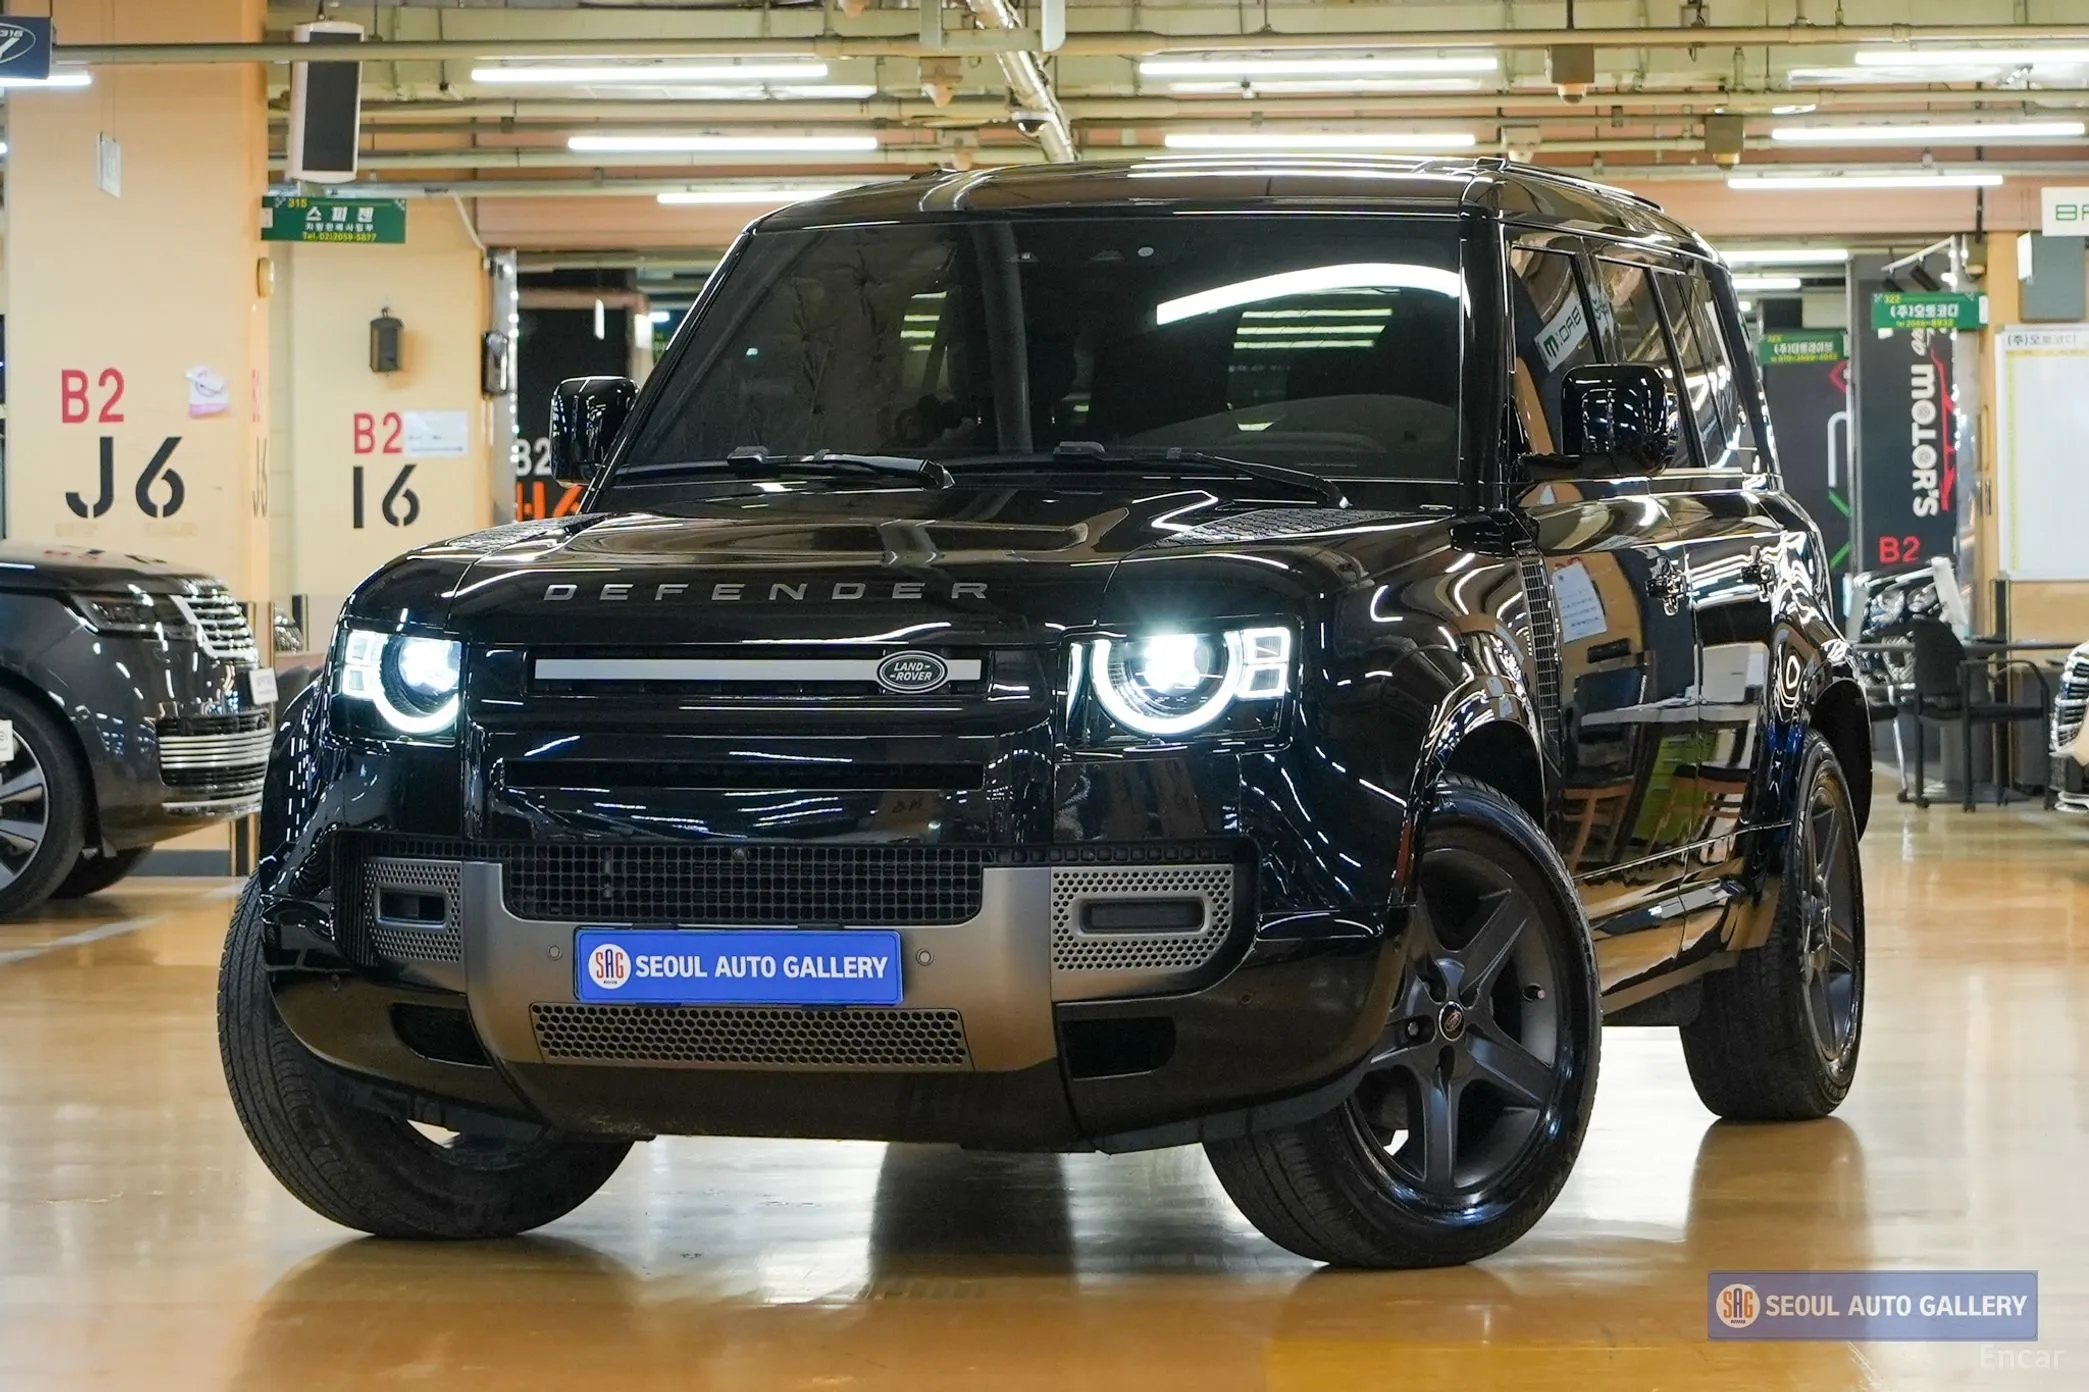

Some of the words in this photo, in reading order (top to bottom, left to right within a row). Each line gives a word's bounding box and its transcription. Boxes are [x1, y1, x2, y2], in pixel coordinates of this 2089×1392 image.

[61, 367, 124, 424] B2
[353, 411, 402, 455] B2
[65, 436, 185, 519] J6
[1879, 536, 1921, 564] B2
[544, 582, 988, 602] DEFENDER
[595, 948, 624, 979] SAG
[635, 956, 707, 978] SEOUL
[715, 956, 776, 979] AUTO
[783, 956, 888, 979] GALLERY
